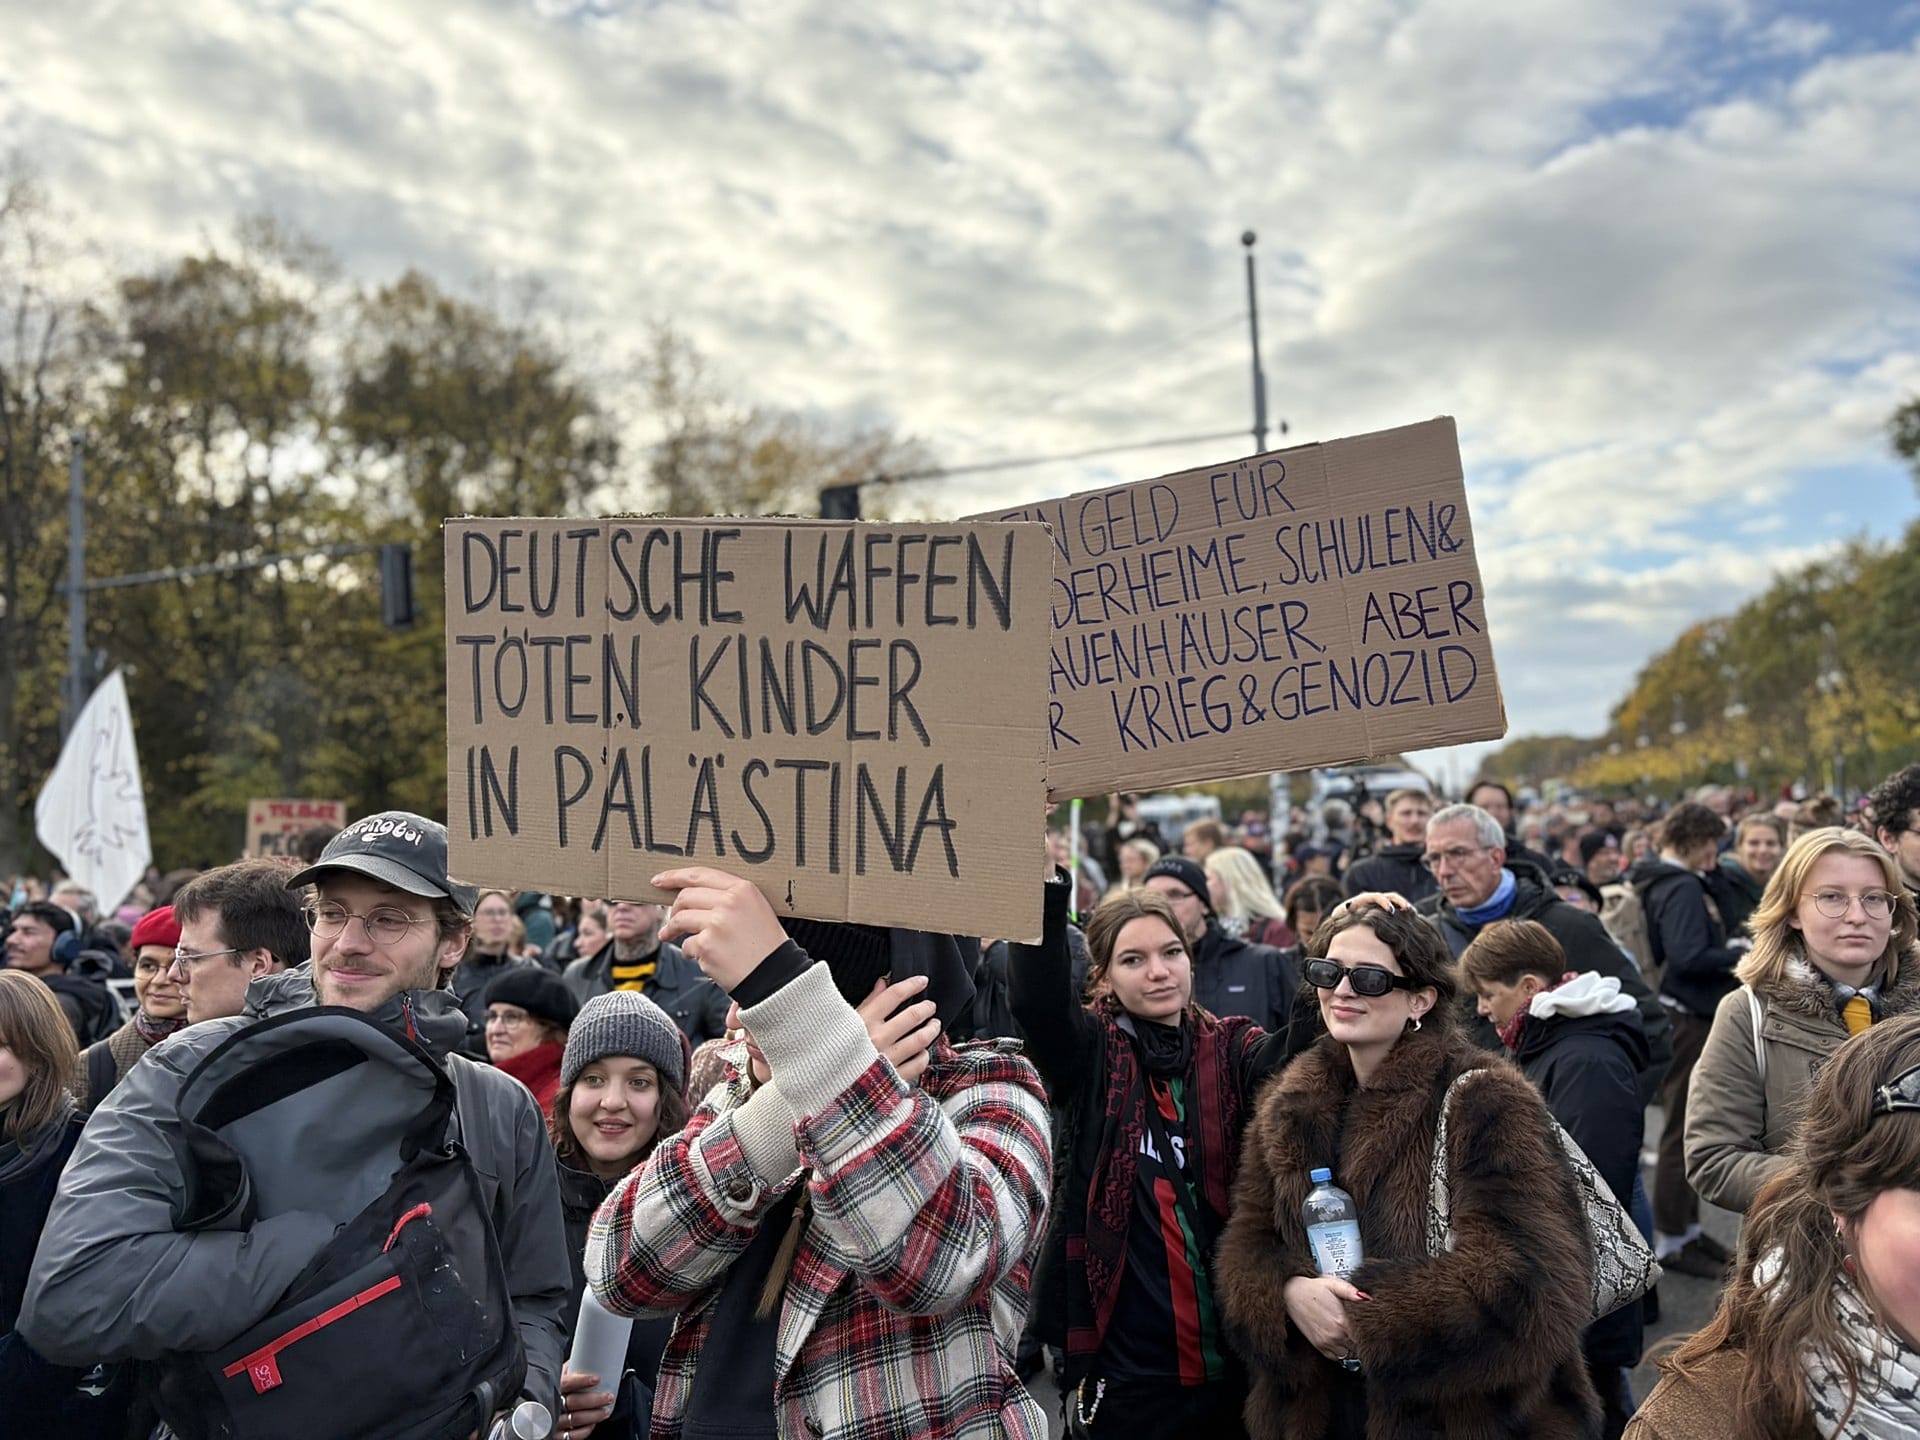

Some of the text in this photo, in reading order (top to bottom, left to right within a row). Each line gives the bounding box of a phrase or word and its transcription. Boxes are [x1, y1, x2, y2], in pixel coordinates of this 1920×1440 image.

[1079, 484, 1180, 557] GELD
[1210, 459, 1296, 528] FÜR
[462, 528, 746, 626] DEUTSCHE
[784, 529, 1015, 632] WAFFEN
[1362, 580, 1480, 645] ABER
[455, 627, 931, 747] TÖTEN KINDER
[467, 744, 959, 878] IN PALÄSTINA
